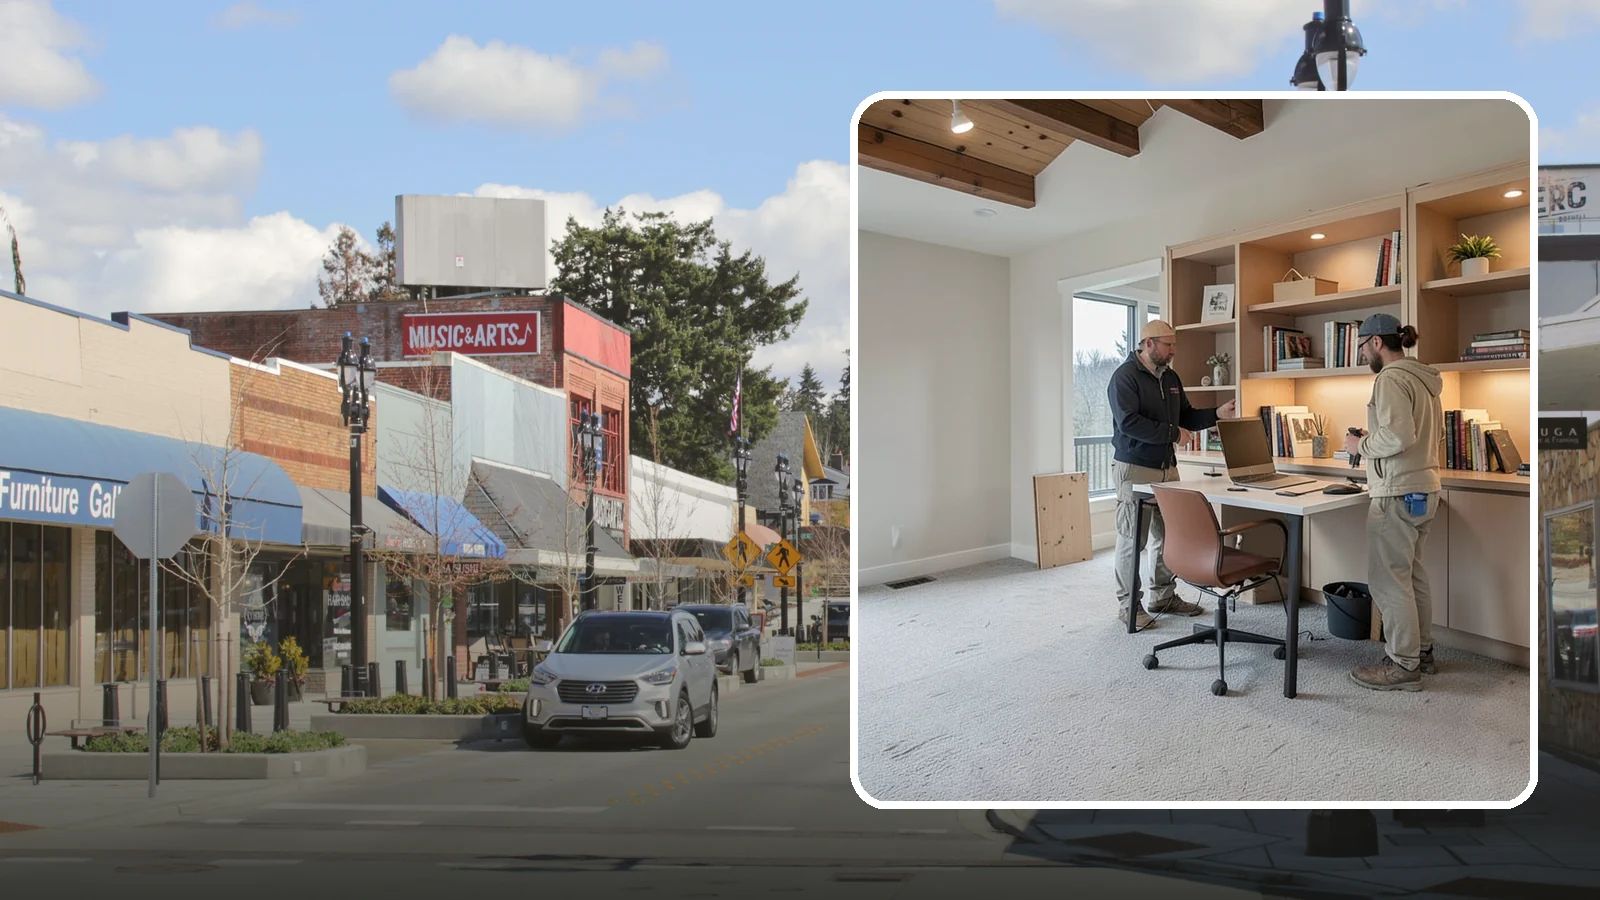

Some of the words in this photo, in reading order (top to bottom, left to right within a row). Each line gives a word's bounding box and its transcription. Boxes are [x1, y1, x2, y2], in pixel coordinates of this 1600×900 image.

[409, 323, 519, 348] MUSIC&ARTS
[1540, 427, 1577, 437] UGA
[1551, 435, 1579, 445] Framing
[0, 471, 79, 515] Furniture
[453, 563, 479, 574] SUSHI
